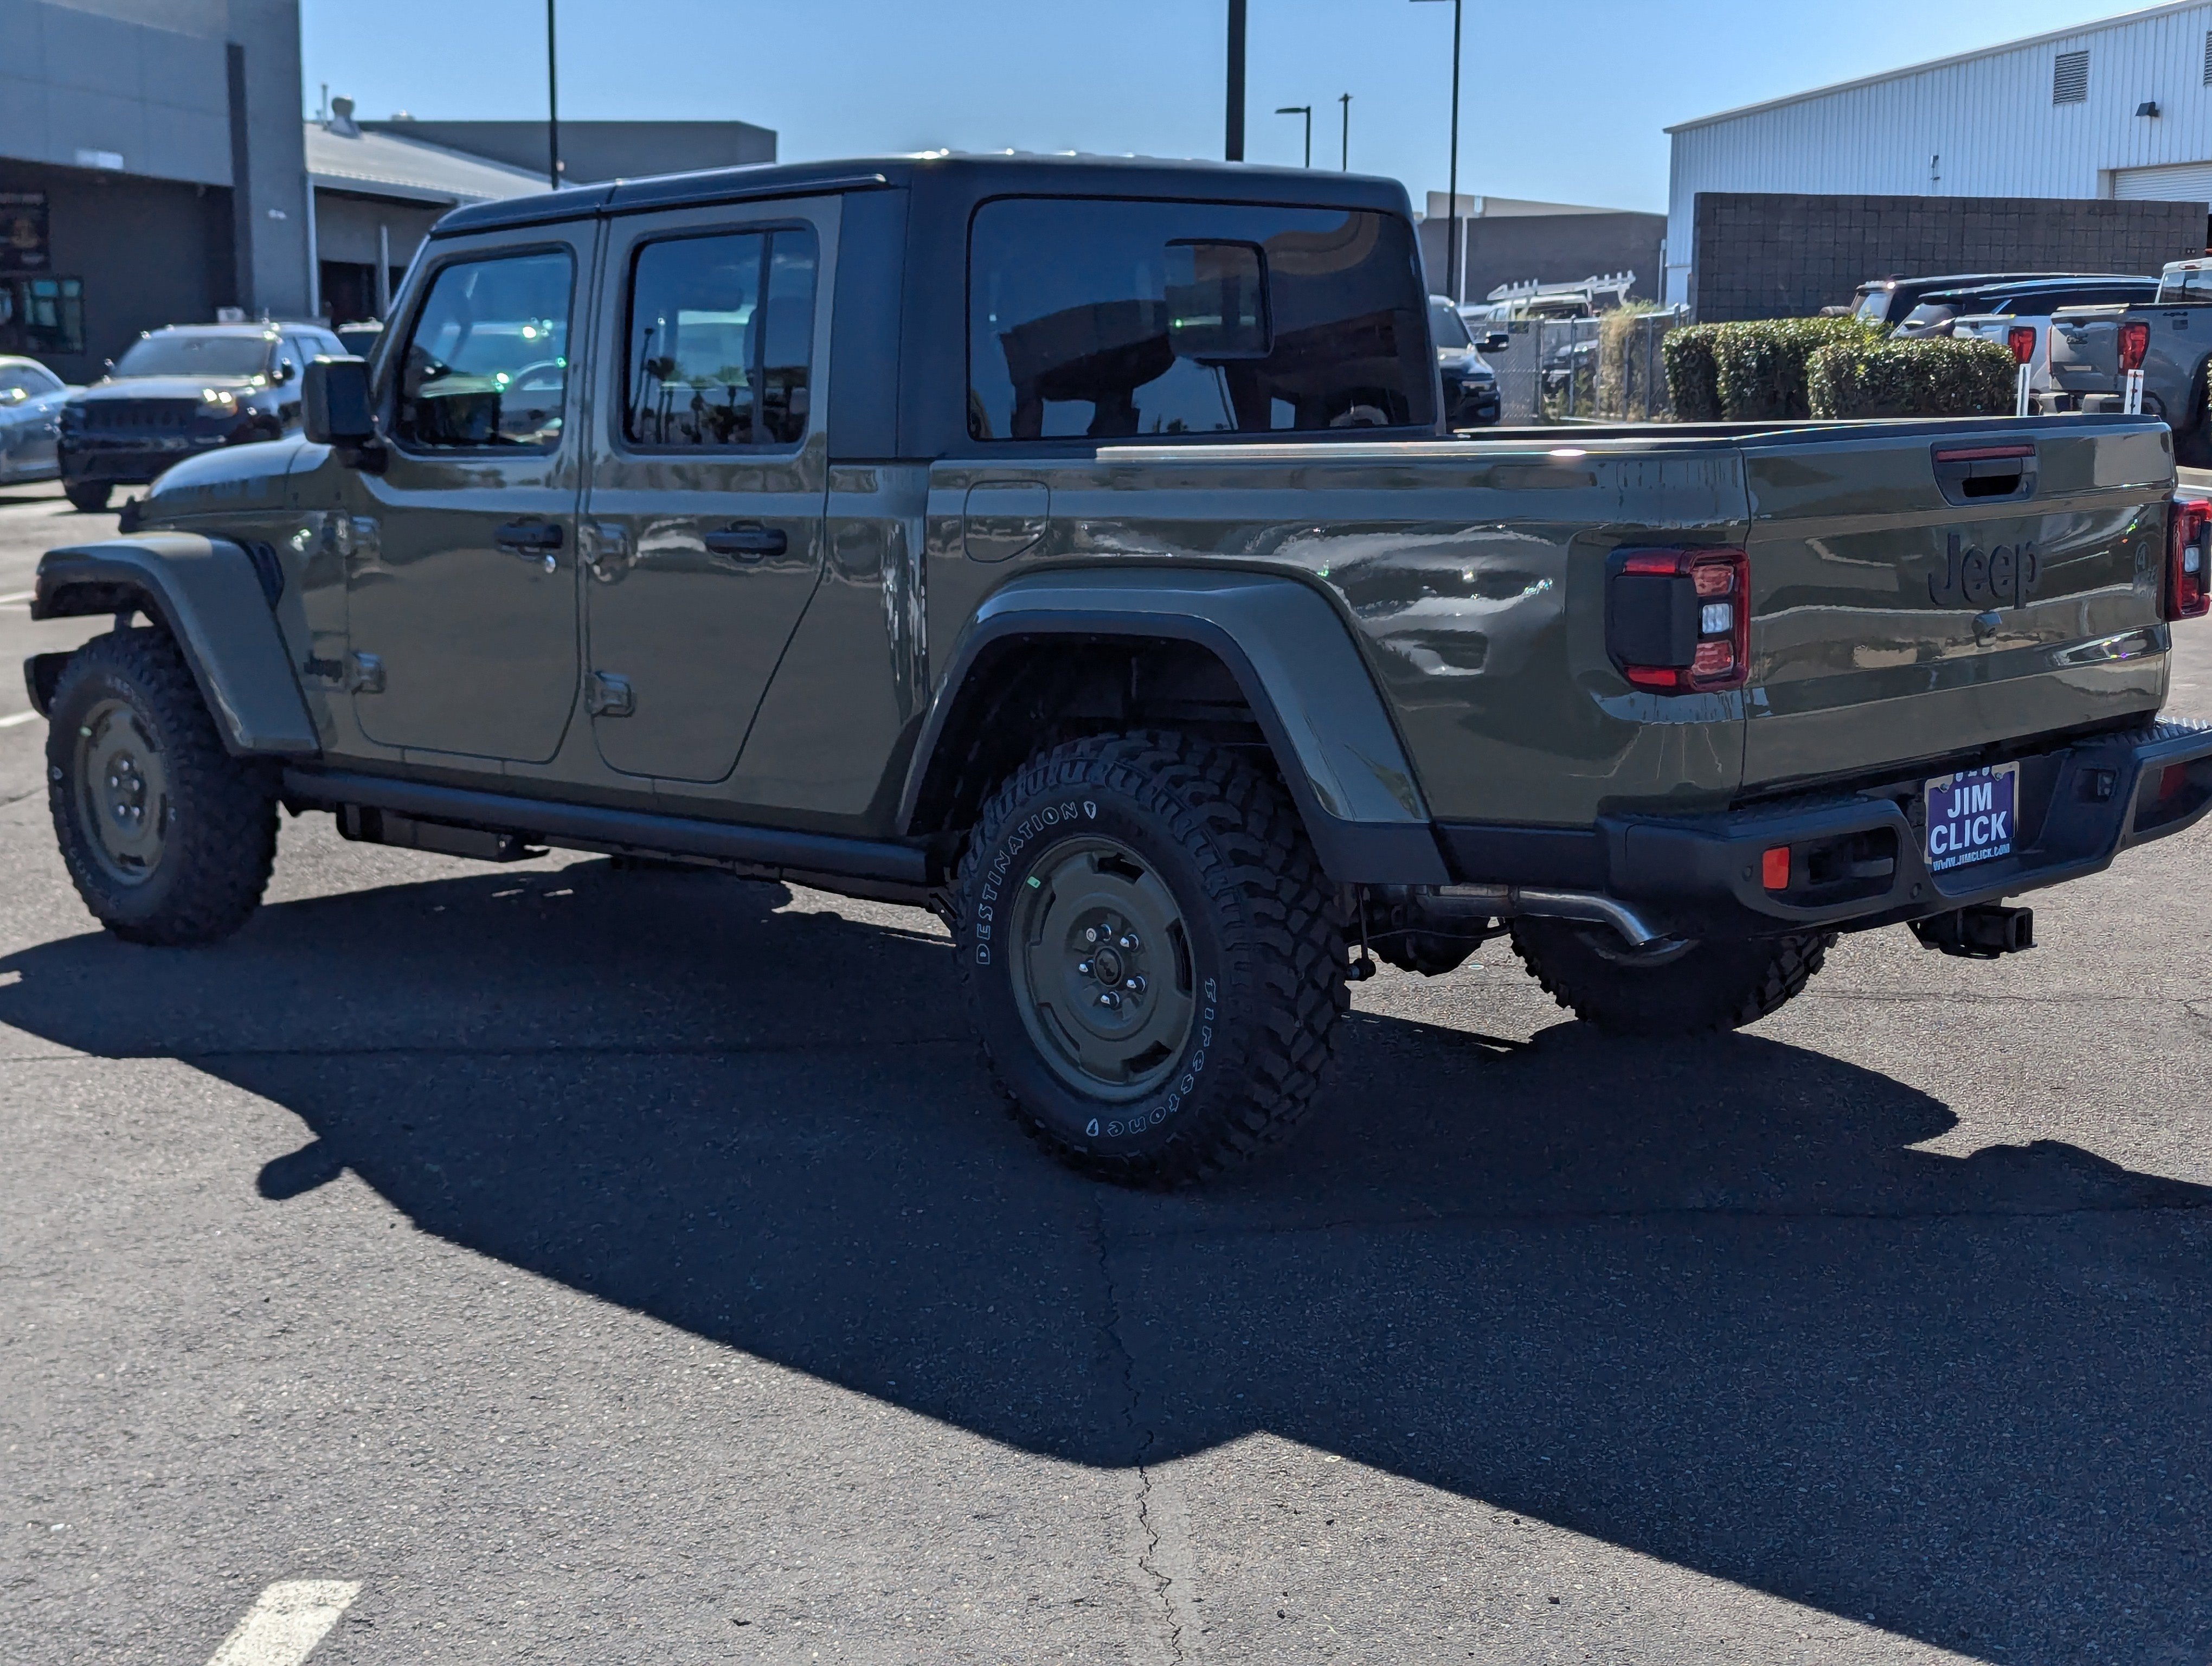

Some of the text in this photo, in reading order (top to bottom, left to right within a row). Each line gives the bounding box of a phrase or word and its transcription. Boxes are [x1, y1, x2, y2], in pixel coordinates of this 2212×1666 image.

[1928, 533, 2042, 610] Jeep
[1931, 811, 2007, 855] CLICK
[1947, 782, 1992, 818] JIM
[976, 801, 1078, 965] DESTINATION
[1107, 978, 1217, 1137] Firestone
